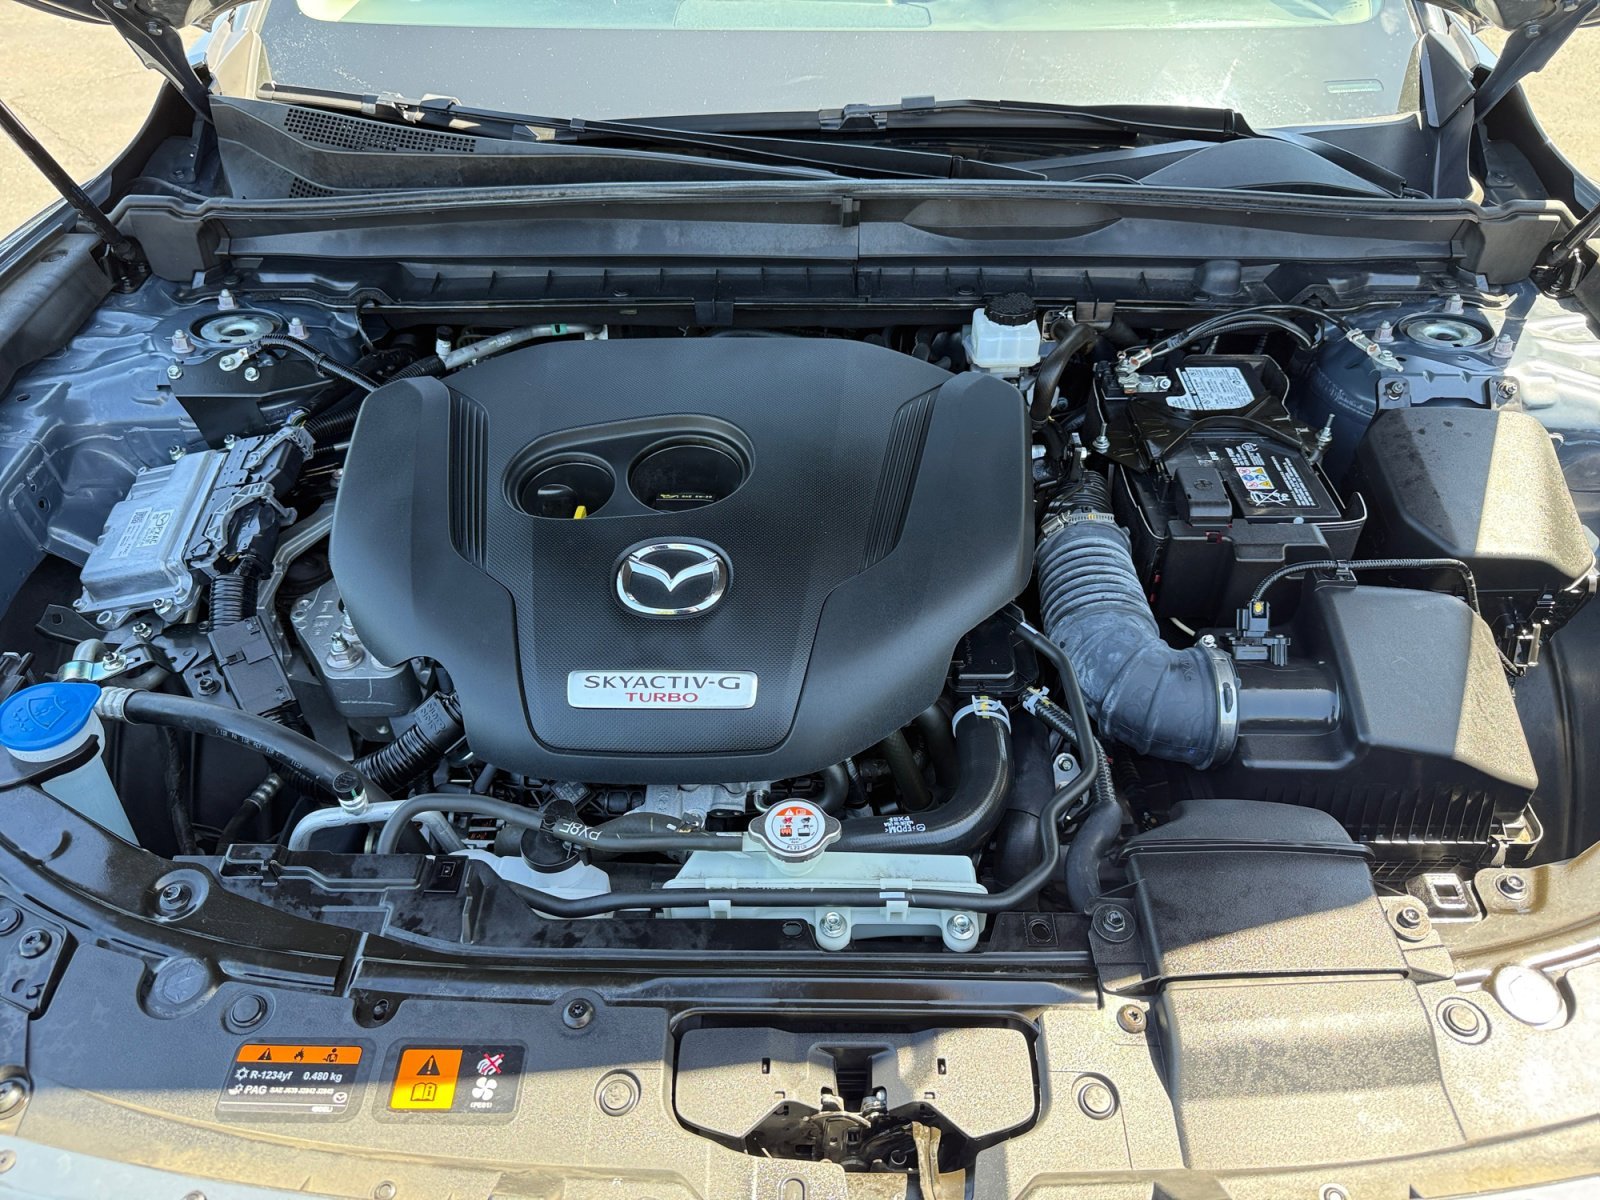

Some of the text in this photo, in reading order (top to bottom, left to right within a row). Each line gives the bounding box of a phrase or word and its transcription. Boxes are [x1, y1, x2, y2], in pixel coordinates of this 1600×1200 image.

[583, 675, 741, 690] SKYACTIV-G
[625, 692, 699, 703] TURBO
[559, 821, 603, 841] PX8F
[249, 1070, 343, 1083] R-1234yf 0.480 kg
[243, 1085, 267, 1095] PAG
